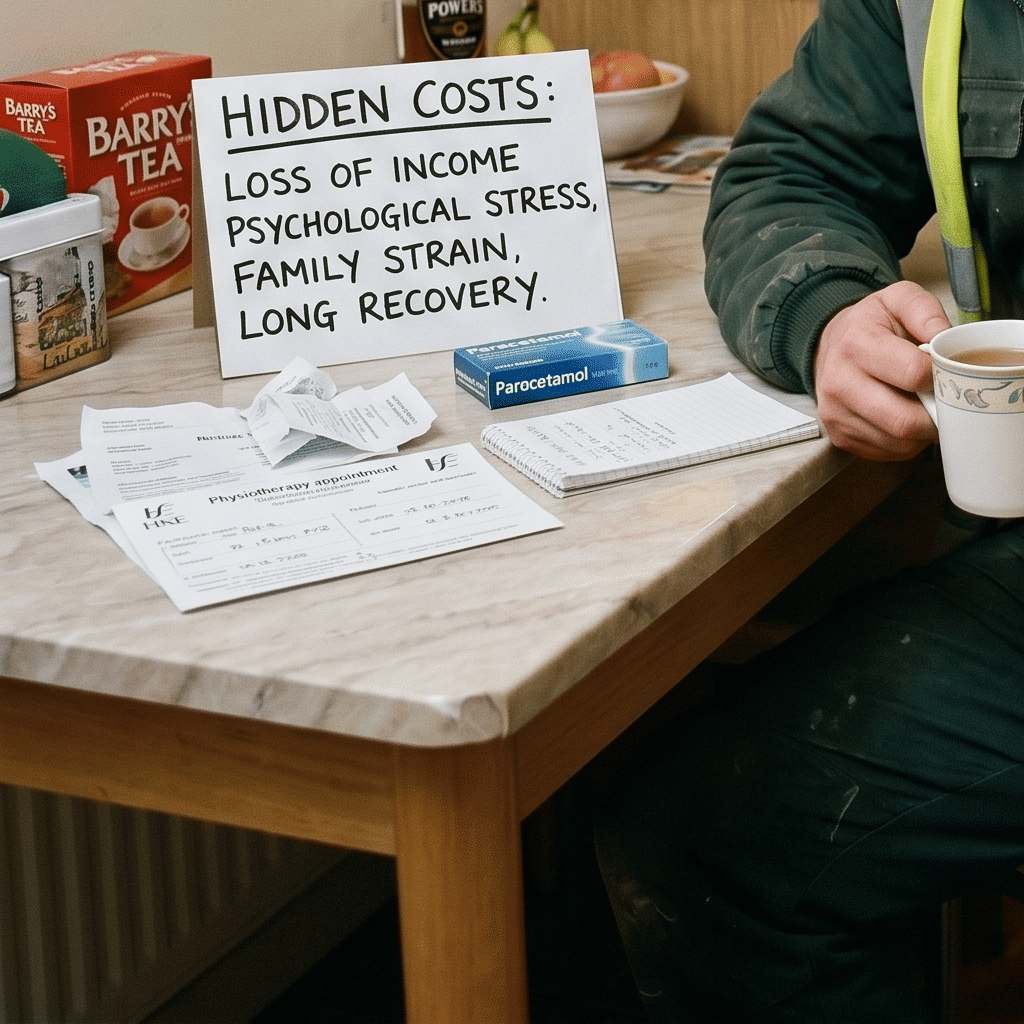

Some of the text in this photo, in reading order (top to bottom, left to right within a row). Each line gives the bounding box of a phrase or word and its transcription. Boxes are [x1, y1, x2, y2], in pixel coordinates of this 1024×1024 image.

[5, 97, 57, 121] BARRY'S
[17, 117, 46, 134] TEA
[221, 85, 390, 140] HIDDEN
[413, 74, 556, 121] COSTS:
[117, 141, 183, 186] TEA
[225, 165, 312, 202] LOSS
[330, 157, 373, 189] OF
[393, 143, 520, 184] INCOME
[226, 181, 598, 248] PSYCHOLOGICAL STRESS,
[233, 232, 521, 295] FAMILY STRAIN,
[239, 271, 548, 340] LONG RECOVERY.
[208, 481, 310, 505] Physiotherapy
